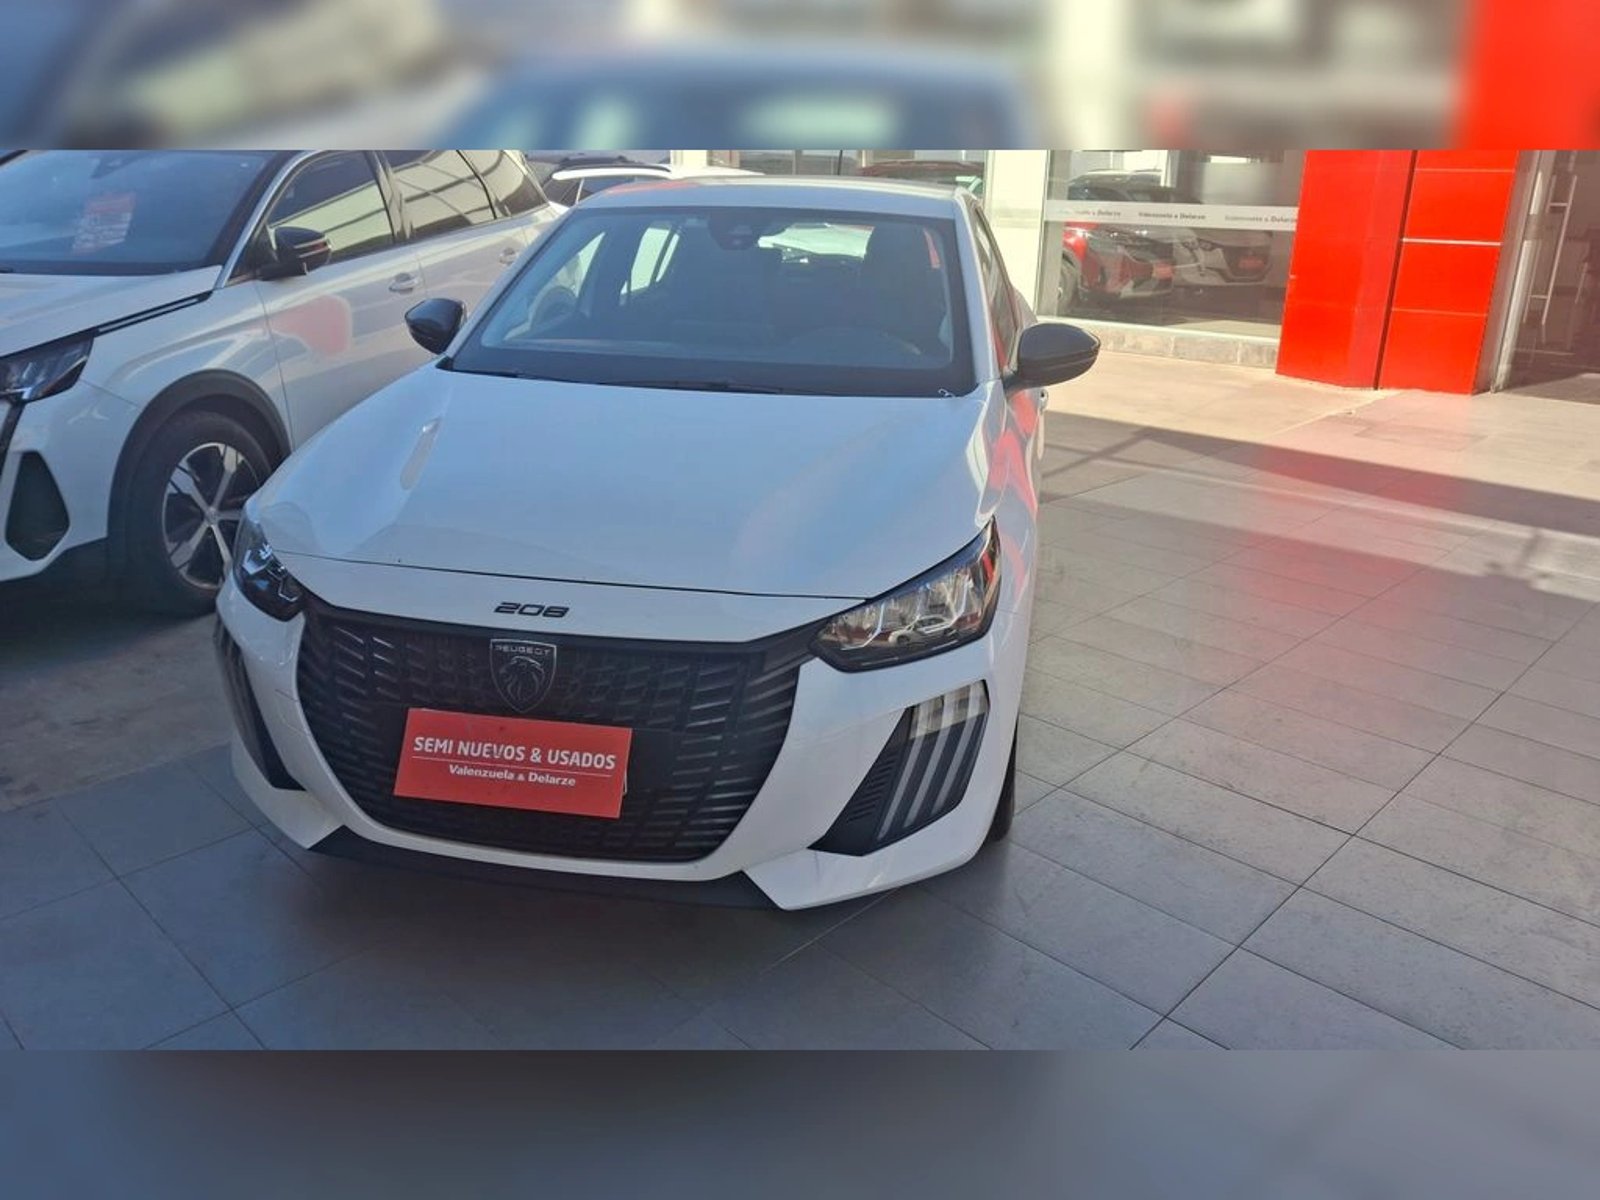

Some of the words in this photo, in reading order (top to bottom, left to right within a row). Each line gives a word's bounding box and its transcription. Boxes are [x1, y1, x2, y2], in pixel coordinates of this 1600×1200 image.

[494, 602, 569, 618] 208
[495, 645, 551, 656] PEUGEOT
[413, 736, 453, 755] SEMI
[457, 740, 526, 762] NUEVOS
[530, 747, 542, 763] &
[547, 749, 617, 770] USADOS
[449, 764, 515, 781] Valenzuela
[528, 771, 576, 787] Delarze
